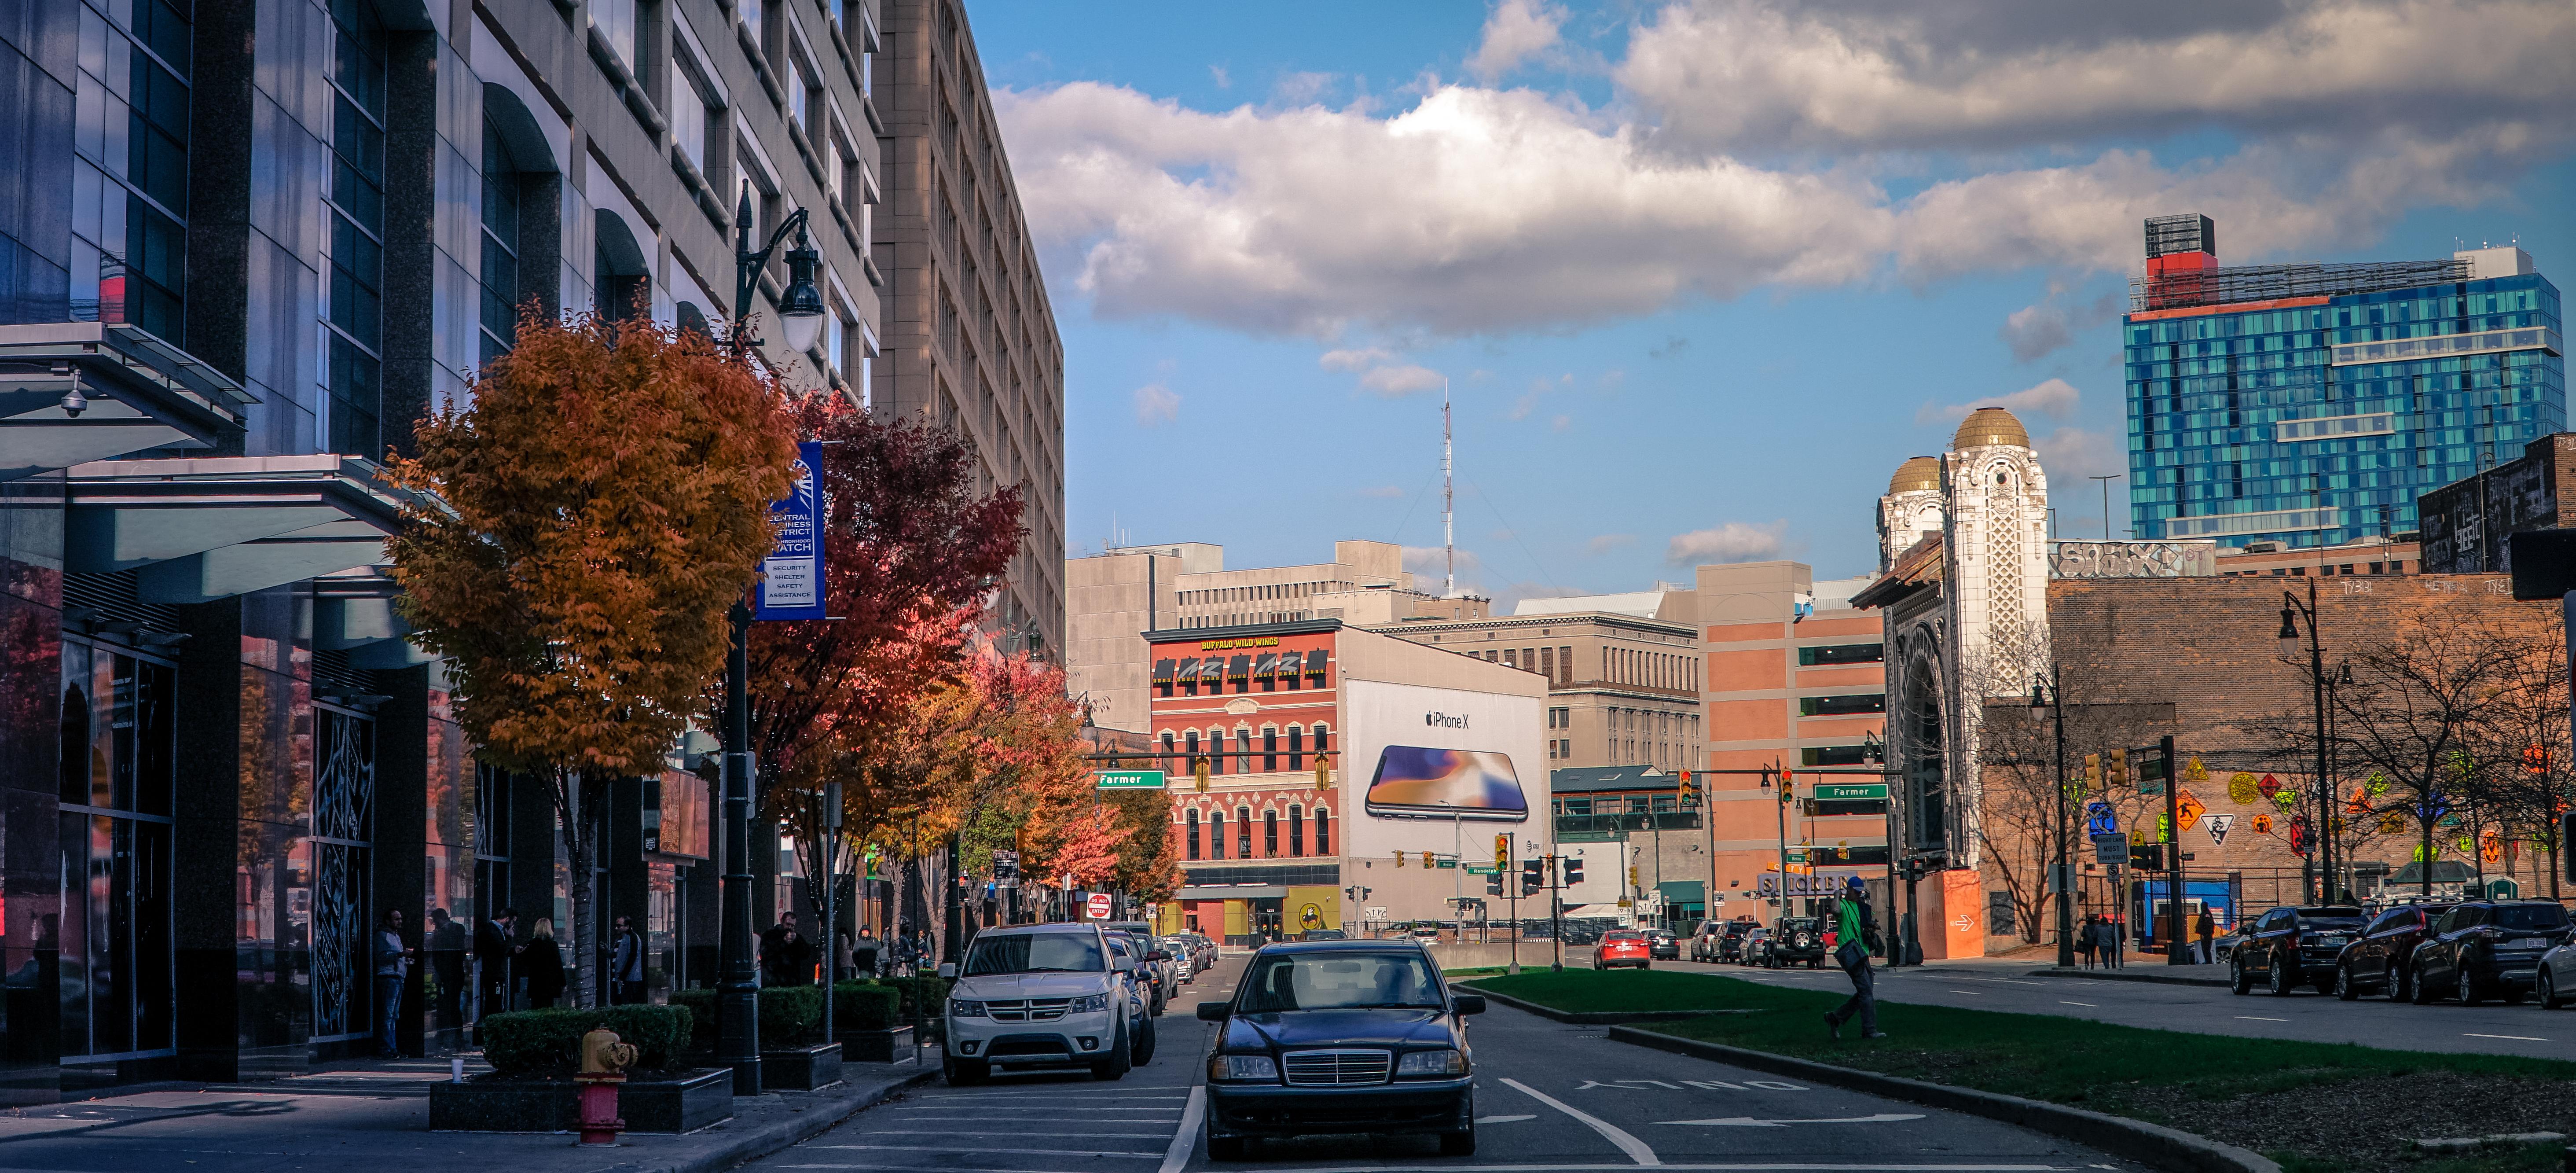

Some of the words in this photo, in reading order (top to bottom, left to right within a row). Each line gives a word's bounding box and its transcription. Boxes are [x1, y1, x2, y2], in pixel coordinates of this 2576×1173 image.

[777, 544, 811, 552] ATCH
[1201, 640, 1233, 650] BUFFALO
[1235, 638, 1253, 647] WILD
[1255, 637, 1279, 646] WINGS
[1434, 711, 1461, 728] iPhone
[1462, 713, 1468, 729] X
[1100, 775, 1141, 784] Farmer
[1774, 864, 1804, 873] CTY
[317, 927, 336, 978] ETROIT
[1574, 1080, 1810, 1090] ONLY
